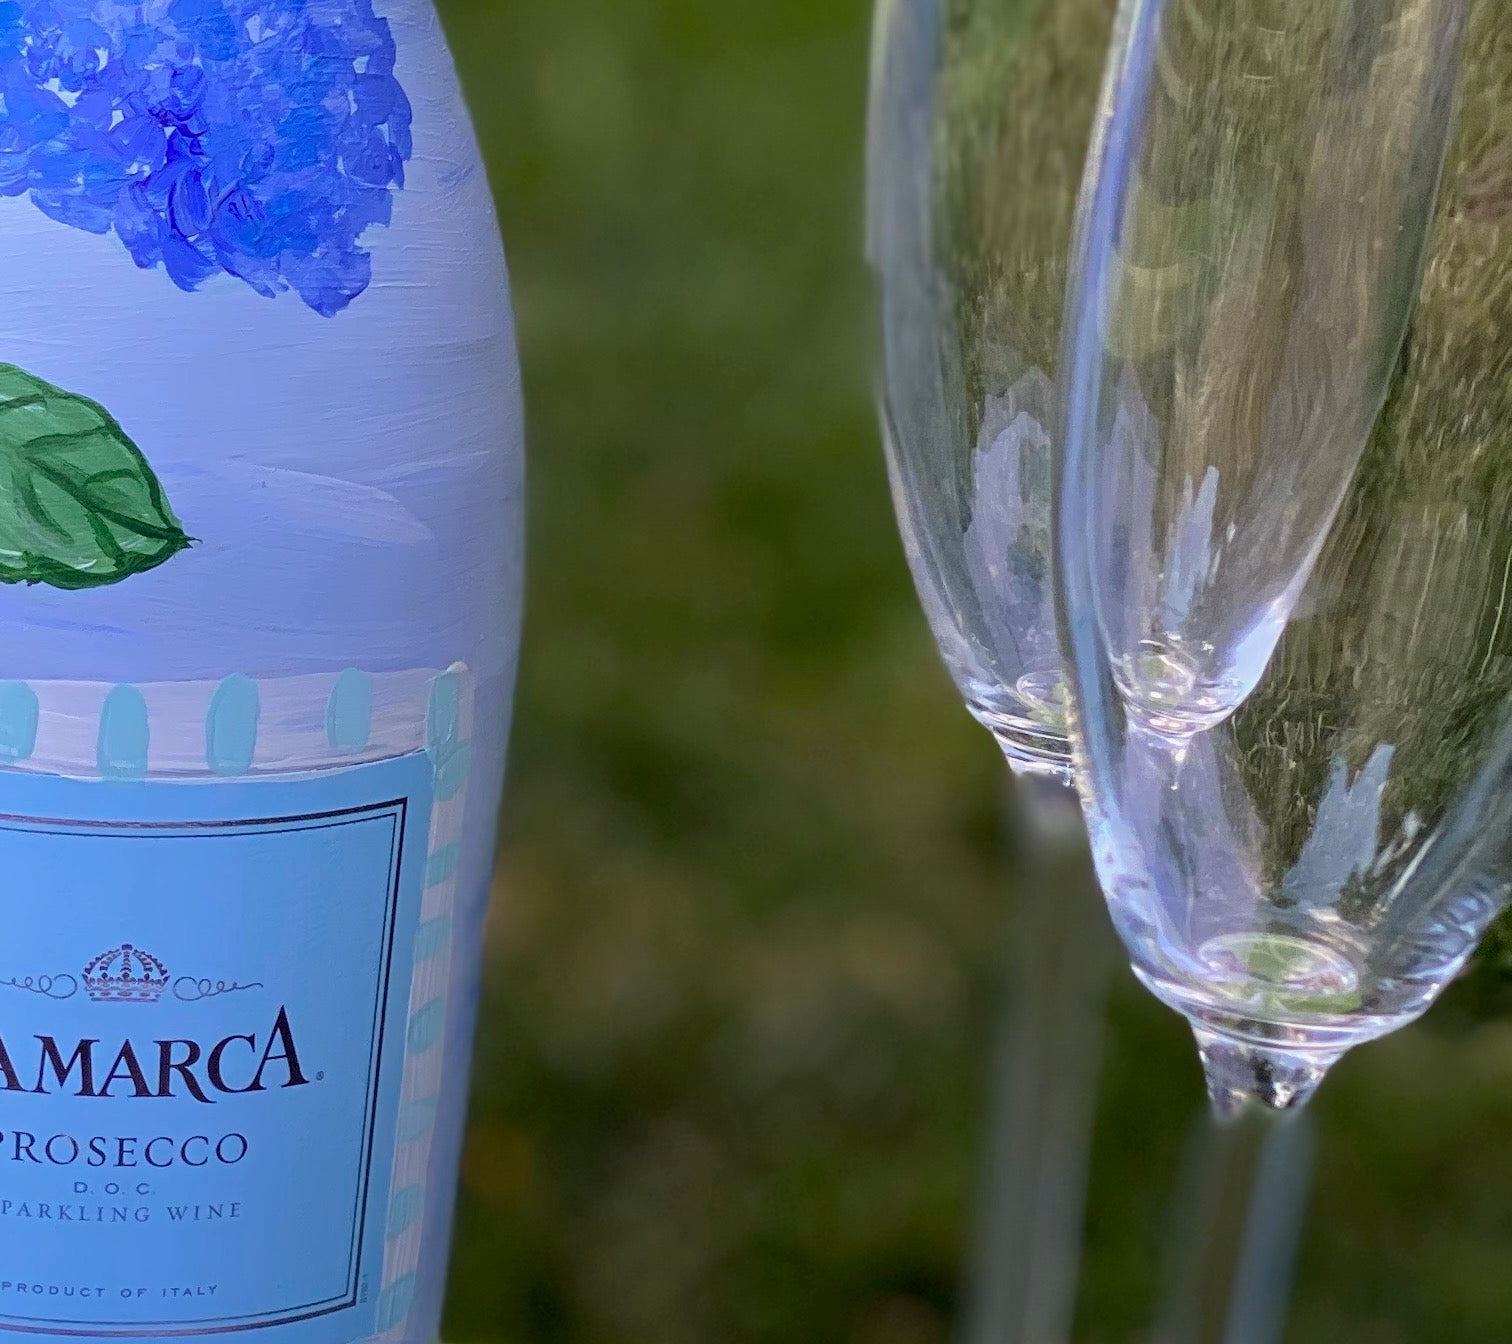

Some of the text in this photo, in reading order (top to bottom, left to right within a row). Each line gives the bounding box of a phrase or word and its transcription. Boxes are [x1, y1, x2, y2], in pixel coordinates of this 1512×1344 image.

[166, 1202, 242, 1222] WINE
[1, 1281, 218, 1298] PRODUCT OF ITALY
